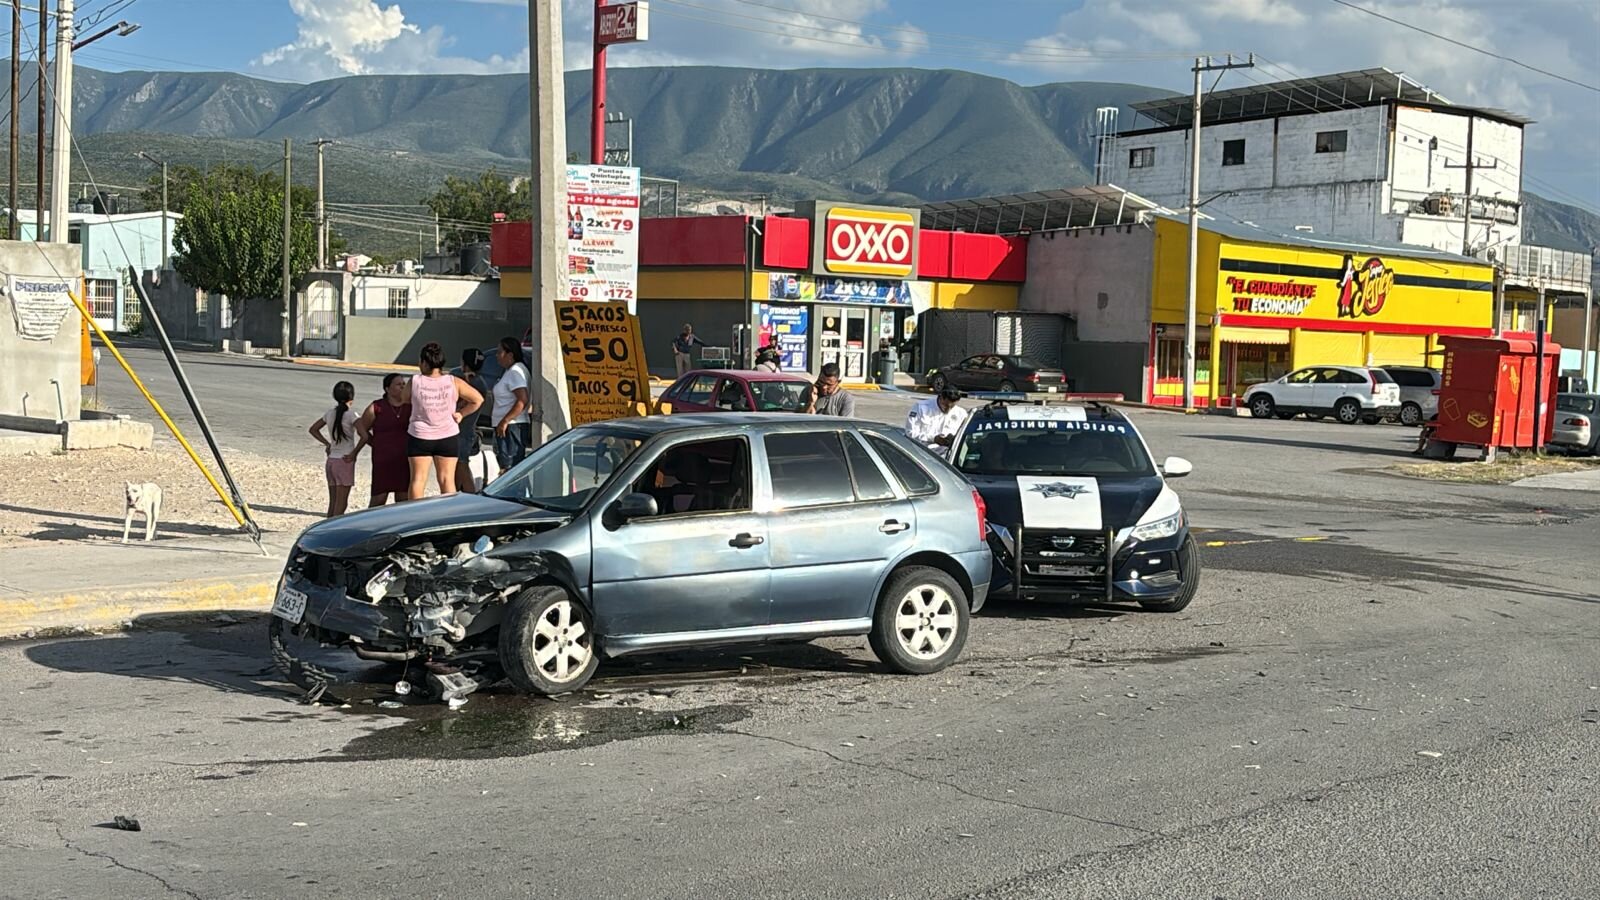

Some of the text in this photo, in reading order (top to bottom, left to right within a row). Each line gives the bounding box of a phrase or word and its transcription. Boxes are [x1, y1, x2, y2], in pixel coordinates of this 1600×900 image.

[617, 6, 636, 29] 24
[607, 198, 636, 206] agosto
[832, 222, 910, 262] OXXO
[16, 281, 69, 292] PRISMA
[1247, 279, 1302, 297] GUARDIÁN
[1301, 285, 1317, 298] DE
[1233, 297, 1250, 312] TU
[560, 305, 625, 331] 5 TACOS
[583, 337, 629, 362] 50
[566, 374, 611, 396] TACOS
